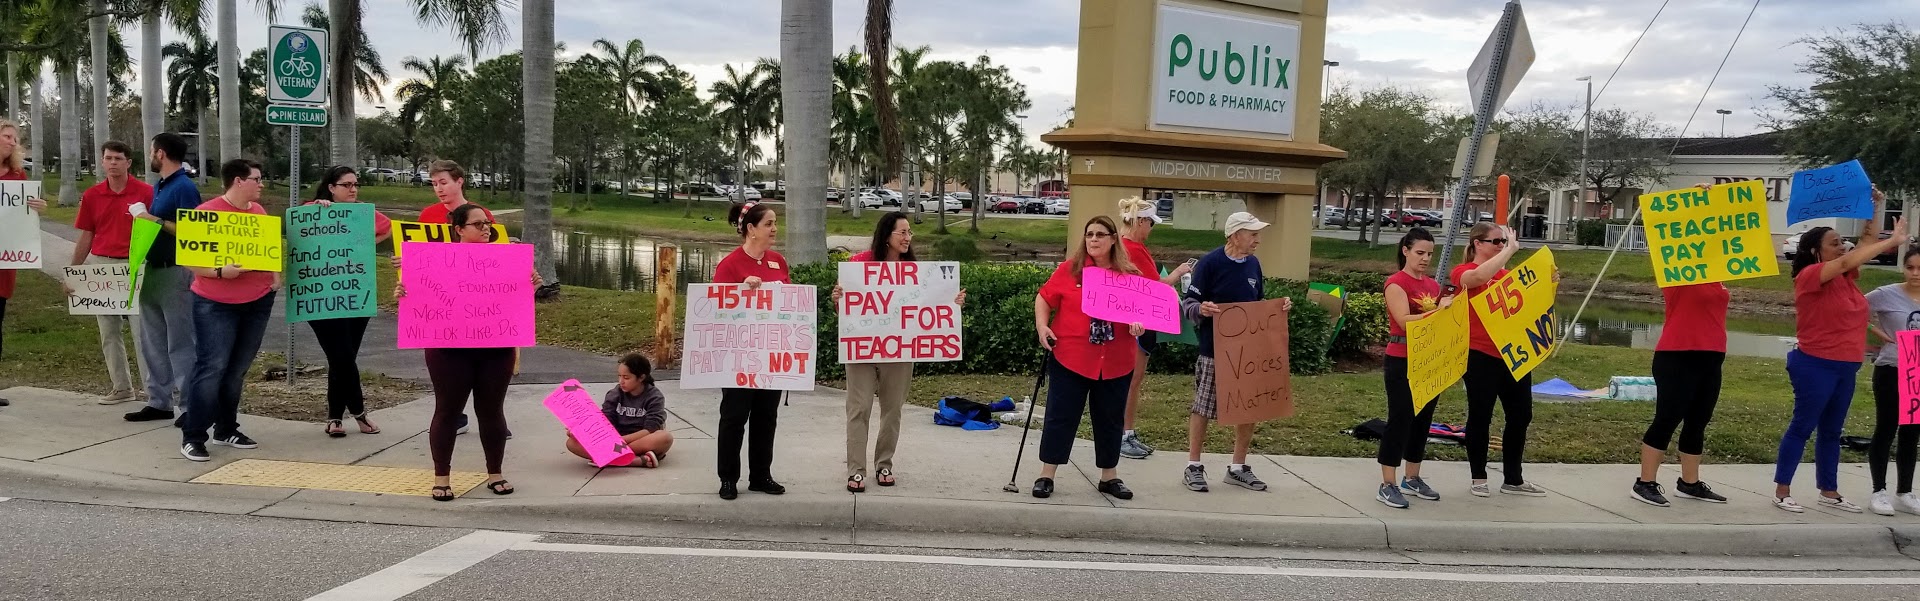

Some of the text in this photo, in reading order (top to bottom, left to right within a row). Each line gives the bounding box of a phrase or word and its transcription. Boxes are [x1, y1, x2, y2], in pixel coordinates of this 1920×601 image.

[1168, 33, 1290, 90] Publix
[278, 76, 317, 89] VETERANS
[1169, 89, 1286, 113] FOOD & PHARMACY
[280, 110, 325, 123] PINE ISLAND
[1150, 160, 1281, 181] MIDPOINT CENTER
[1803, 173, 1836, 189] Base
[1650, 186, 1753, 213] 45TH IN
[177, 209, 260, 227] FUND OUR
[290, 206, 353, 225] Fund our
[1654, 212, 1761, 240] TEACHER
[178, 239, 280, 259] VOTE PUBLIC
[289, 245, 354, 264] fund our
[444, 250, 456, 268] U
[1661, 236, 1744, 265] PAY IS
[63, 266, 87, 282] Pay
[92, 266, 107, 276] us
[863, 262, 919, 286] FAIR
[1663, 256, 1762, 282] NOT OK
[87, 280, 115, 293] OUR
[289, 278, 361, 297] FUND OUR
[458, 280, 518, 294] EDUKATON
[1104, 270, 1152, 295] HONK
[1485, 265, 1537, 320] 45th
[70, 294, 117, 310] Depends
[296, 290, 370, 316] FUTURE!
[707, 285, 815, 313] 45TH IN
[844, 290, 895, 316] PAY
[1087, 290, 1172, 322] 4 Public Ed
[413, 303, 502, 322] MORE SIGNS
[901, 305, 954, 331] FOR
[1218, 305, 1276, 338] Our
[406, 325, 430, 340] WIL
[434, 326, 458, 341] LOK
[693, 323, 814, 351] TEACHER'S
[840, 334, 960, 360] TEACHERS
[1500, 342, 1529, 372] Is
[689, 350, 809, 375] PAY IS NOT
[1225, 346, 1283, 380] Voices
[1425, 368, 1452, 396] CHILD!
[1226, 384, 1289, 414] Matter!
